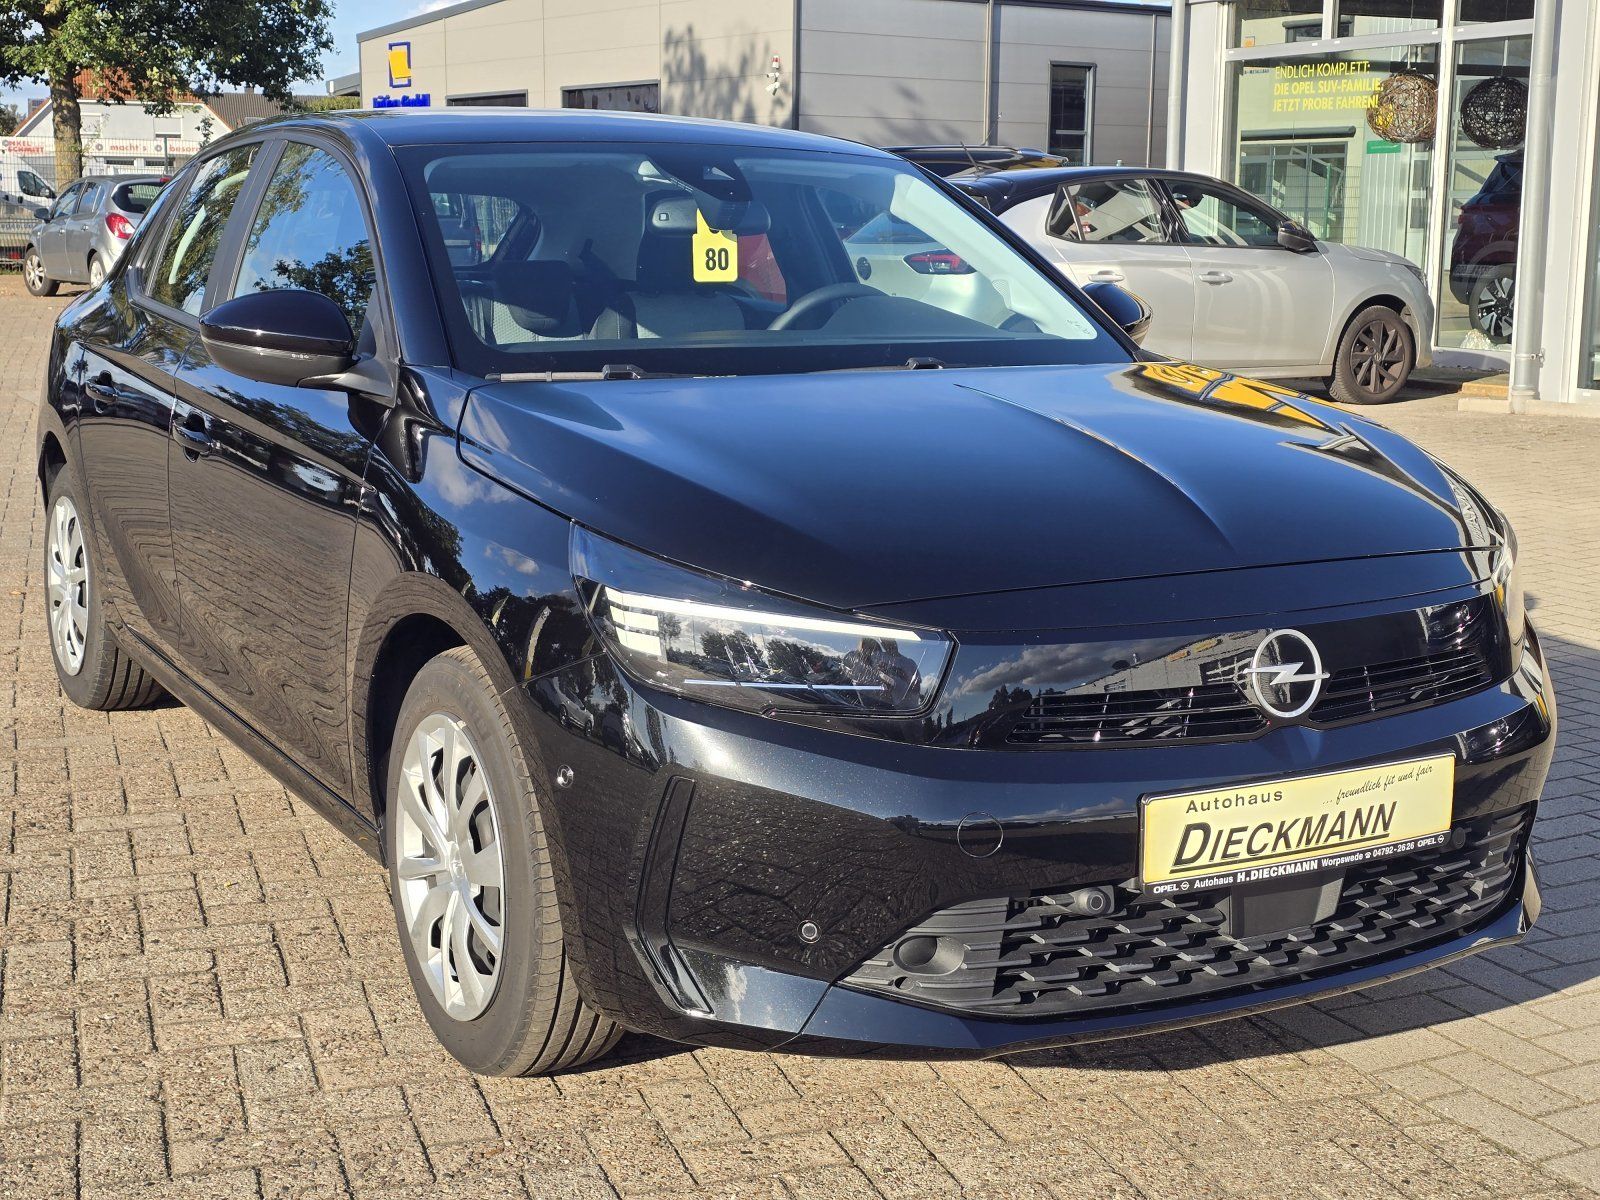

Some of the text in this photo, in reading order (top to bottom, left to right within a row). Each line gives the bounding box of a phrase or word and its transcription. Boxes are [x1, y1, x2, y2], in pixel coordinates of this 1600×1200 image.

[1275, 65, 1315, 79] ENDLICH
[1316, 61, 1371, 77] KOMPLETT:
[1274, 82, 1289, 96] DIE
[1291, 81, 1316, 95] OPEL
[1272, 94, 1380, 112] JETZT PROBE FAHREN!
[705, 247, 729, 271] 80
[1383, 774, 1396, 792] fit
[1397, 767, 1414, 783] und
[1415, 764, 1433, 781] fair
[1185, 790, 1284, 814] Autohaus
[1172, 800, 1398, 867] DIECKMANN
[1153, 837, 1437, 894] OPEL Autohaus H.DIECKMANN Worpswede 04792-2626 OPEL
